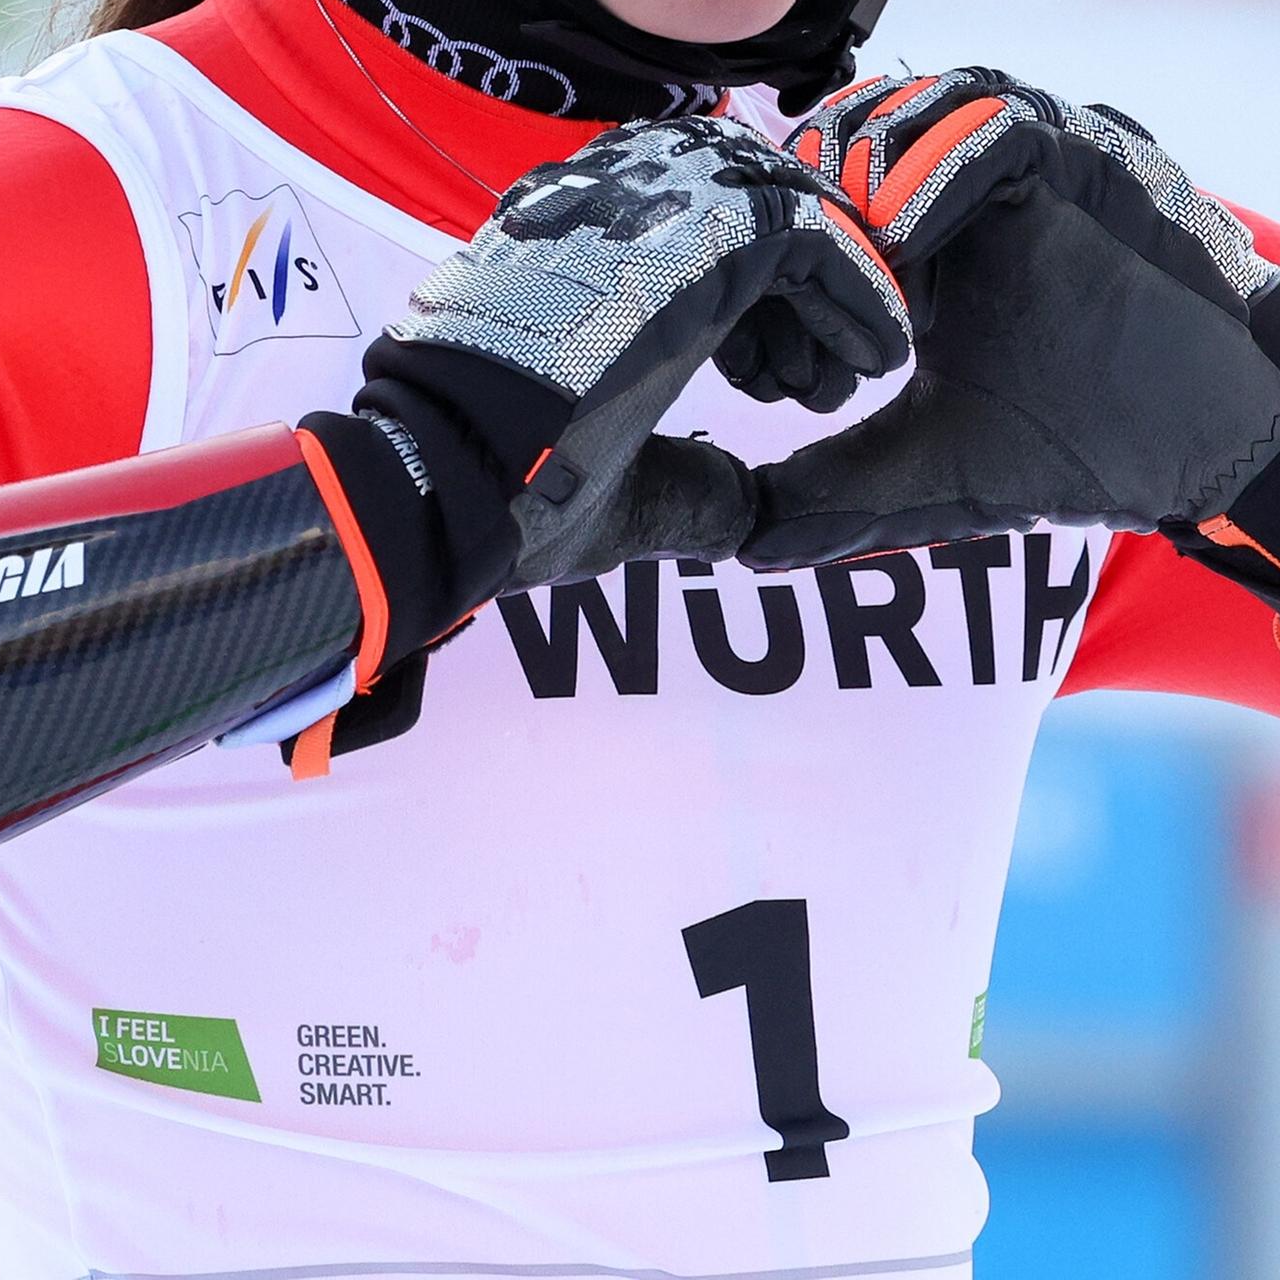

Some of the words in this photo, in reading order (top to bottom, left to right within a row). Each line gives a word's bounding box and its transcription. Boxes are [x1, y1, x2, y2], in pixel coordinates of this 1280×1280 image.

[495, 533, 1090, 698] WÜRTH
[98, 1015, 110, 1038] I
[116, 1017, 175, 1043] FEEL
[296, 1024, 387, 1048] GREEN.
[681, 898, 850, 1182] 1
[104, 1042, 228, 1073] SLOVENIA
[298, 1054, 421, 1077] CREATIVE.
[299, 1082, 392, 1106] SMART.
